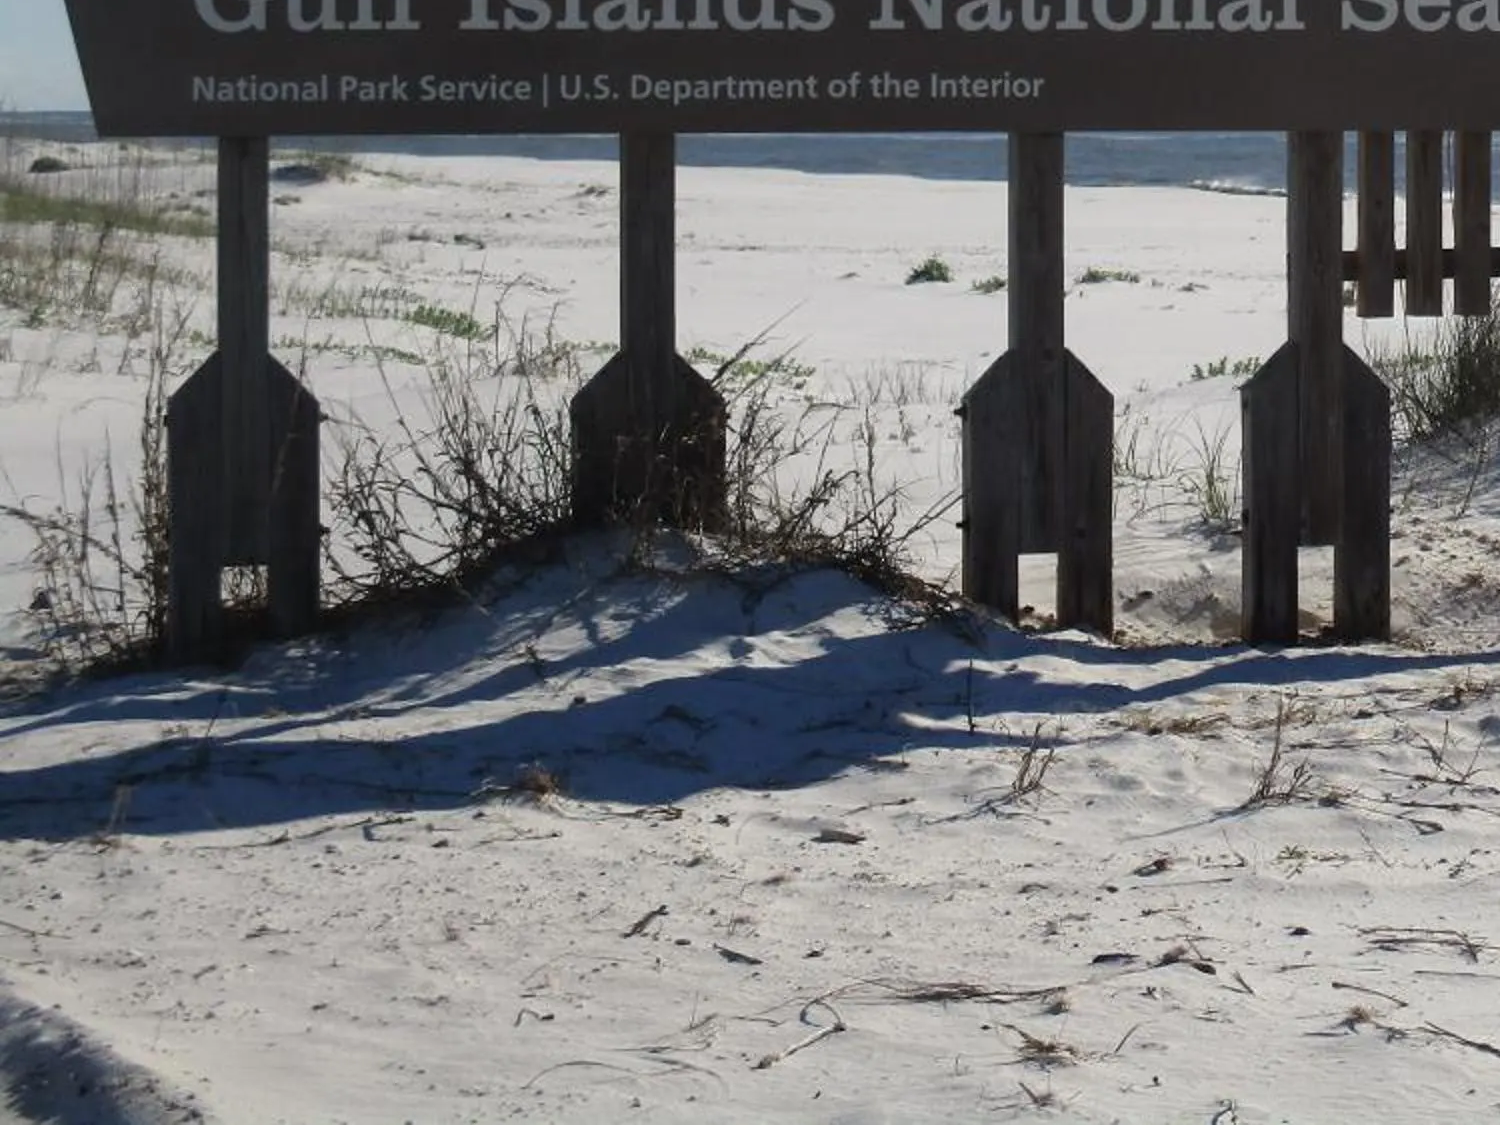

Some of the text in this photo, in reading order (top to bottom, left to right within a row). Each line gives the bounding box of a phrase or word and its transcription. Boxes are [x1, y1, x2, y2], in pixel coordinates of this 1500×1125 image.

[192, 74, 328, 103] National
[340, 74, 408, 102] Park
[419, 74, 532, 102] Service
[560, 74, 619, 101] U.S.
[630, 74, 819, 106] Department
[827, 71, 862, 100] of
[869, 71, 921, 100] the
[930, 71, 1045, 100] Interior
